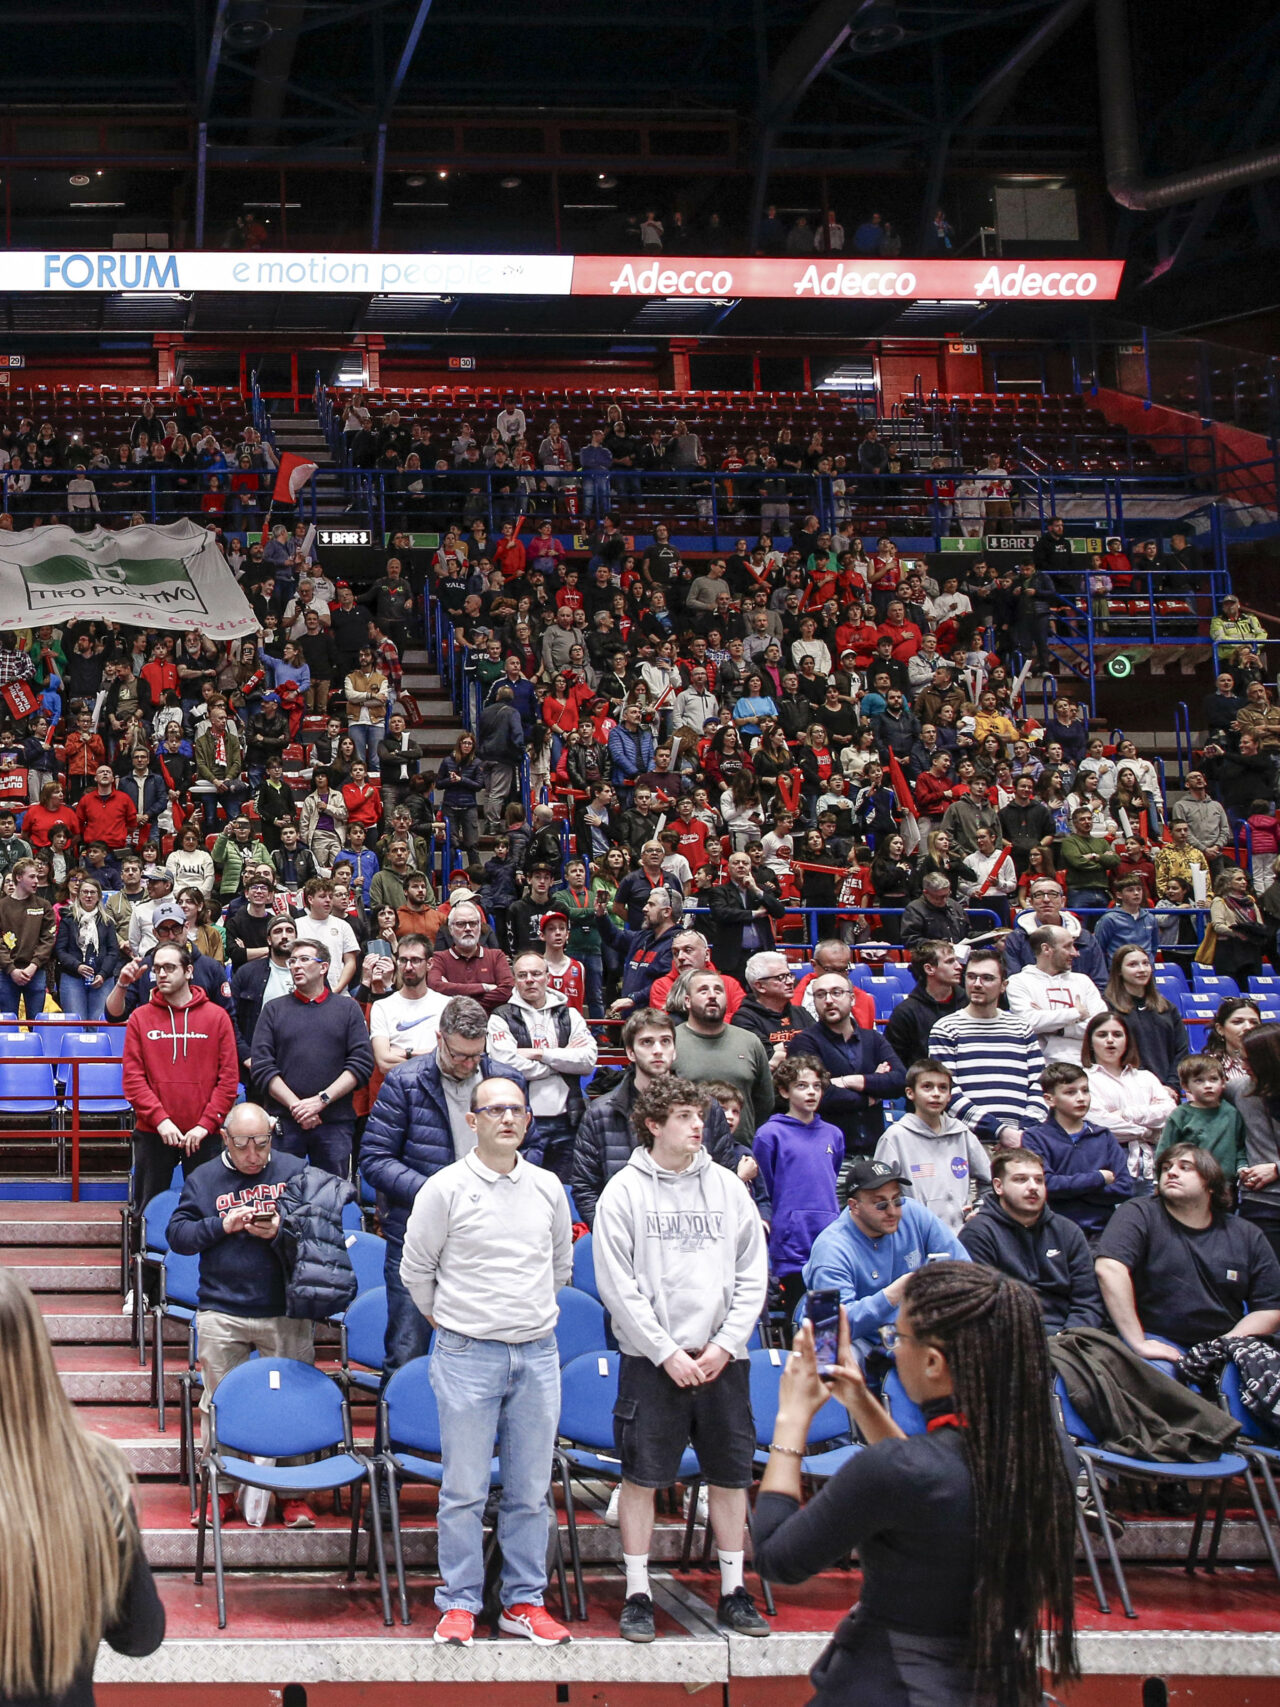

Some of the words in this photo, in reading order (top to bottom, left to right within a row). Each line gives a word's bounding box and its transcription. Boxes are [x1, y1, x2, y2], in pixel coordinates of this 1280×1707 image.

[44, 254, 179, 288] FORUM
[233, 261, 250, 282] e
[257, 256, 368, 284] motion
[382, 256, 490, 290] people
[610, 262, 732, 294] Adecco
[794, 264, 915, 296] Adecco
[974, 265, 1096, 296] Adecco
[965, 343, 974, 351] 31
[10, 357, 20, 365] 29
[332, 532, 358, 544] BAR
[1000, 538, 1025, 549] BAR
[446, 582, 466, 590] YALE
[7, 686, 26, 714] MILANO
[14, 683, 31, 711] OLIMPIA
[176, 863, 205, 874] PARIS
[147, 1030, 208, 1040] Champion
[217, 1183, 286, 1210] OLIMPIA
